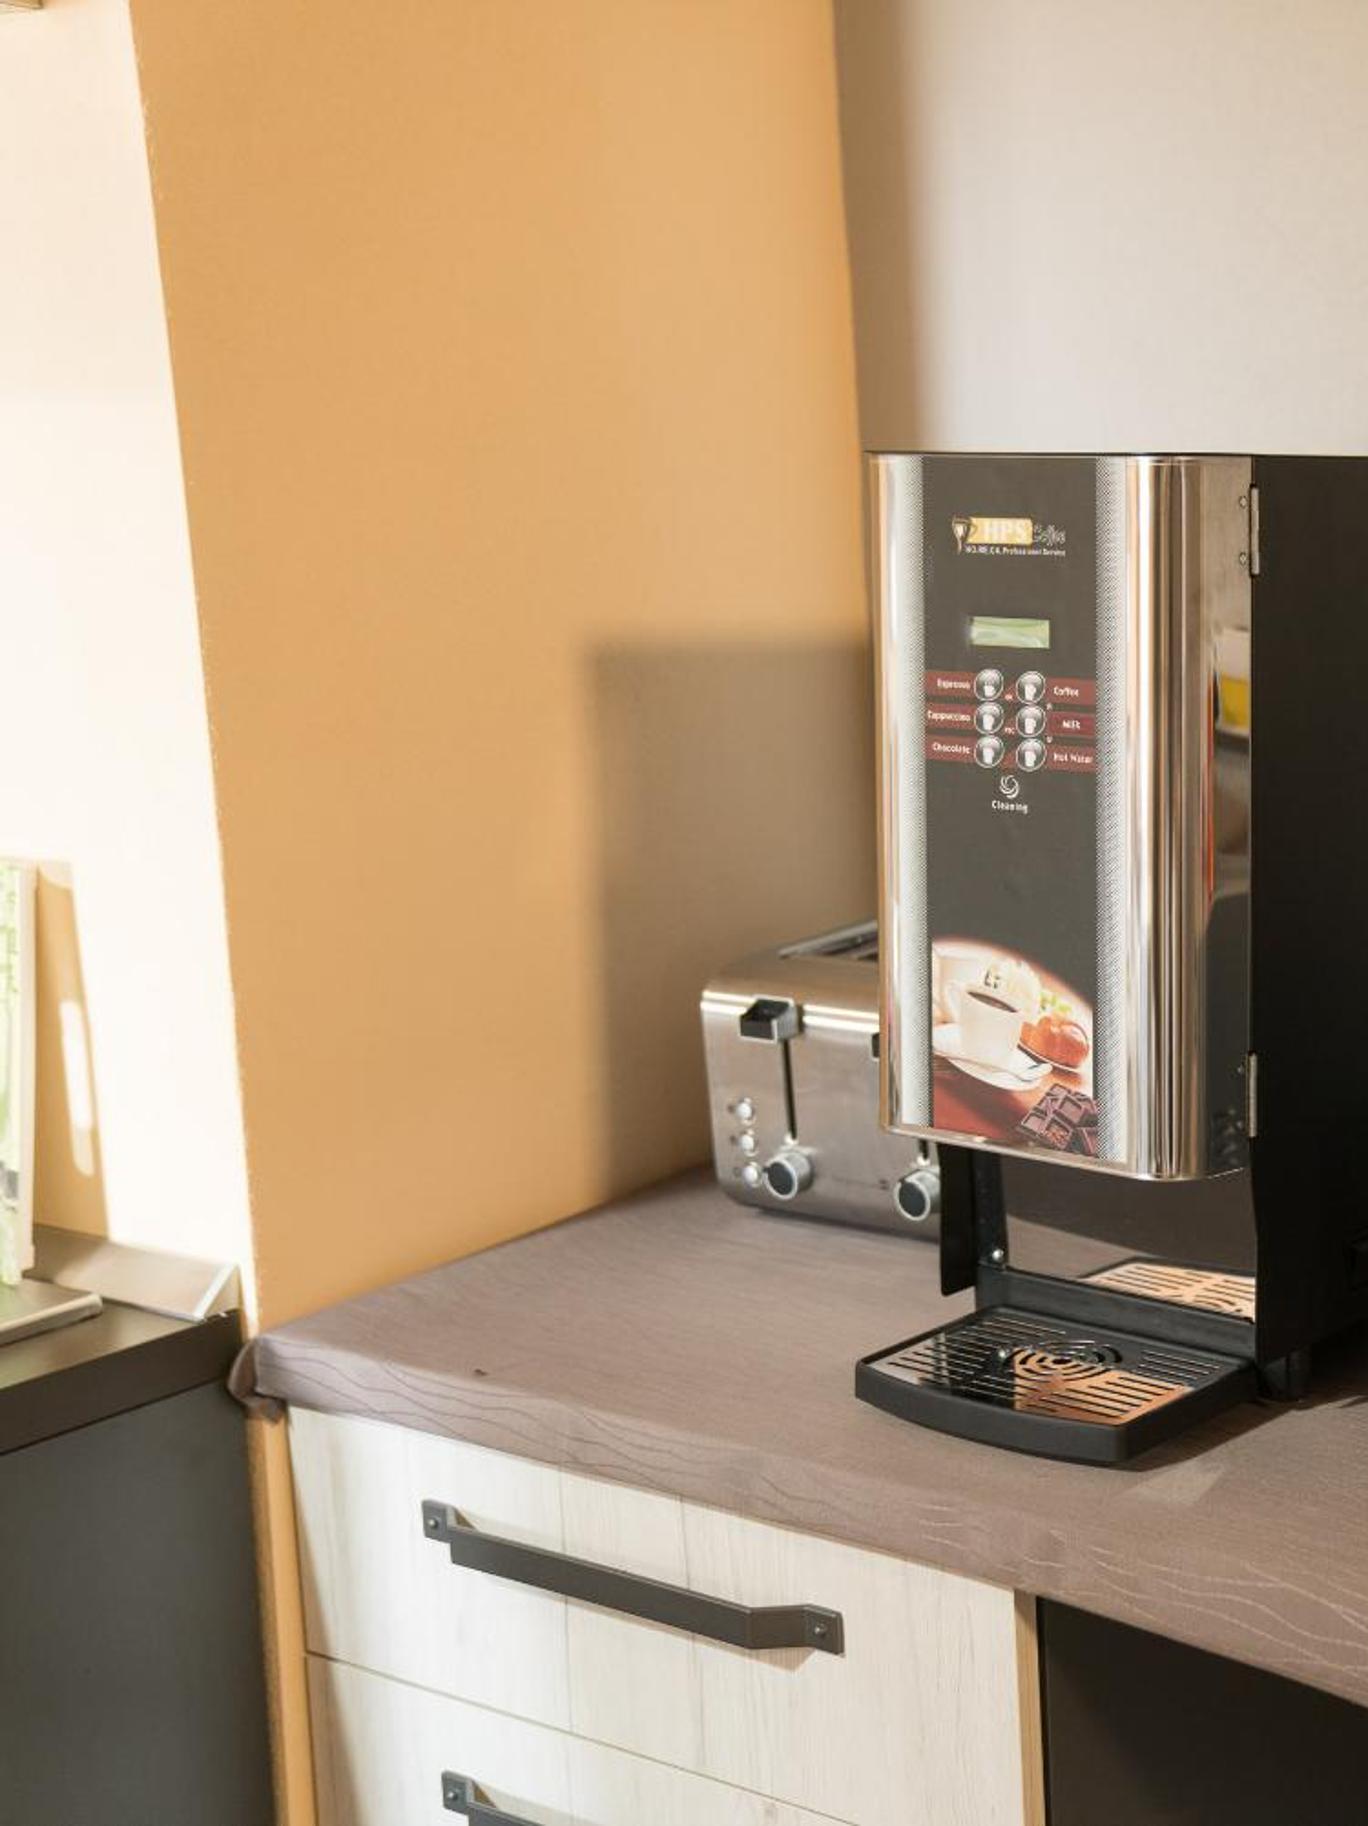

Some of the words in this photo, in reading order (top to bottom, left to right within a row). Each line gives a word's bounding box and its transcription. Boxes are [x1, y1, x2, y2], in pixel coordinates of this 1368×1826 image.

[1053, 687, 1080, 698] Coffee
[927, 709, 971, 723] Cappuccino
[932, 740, 970, 755] Chocolate
[991, 800, 1029, 814] Cleaning
